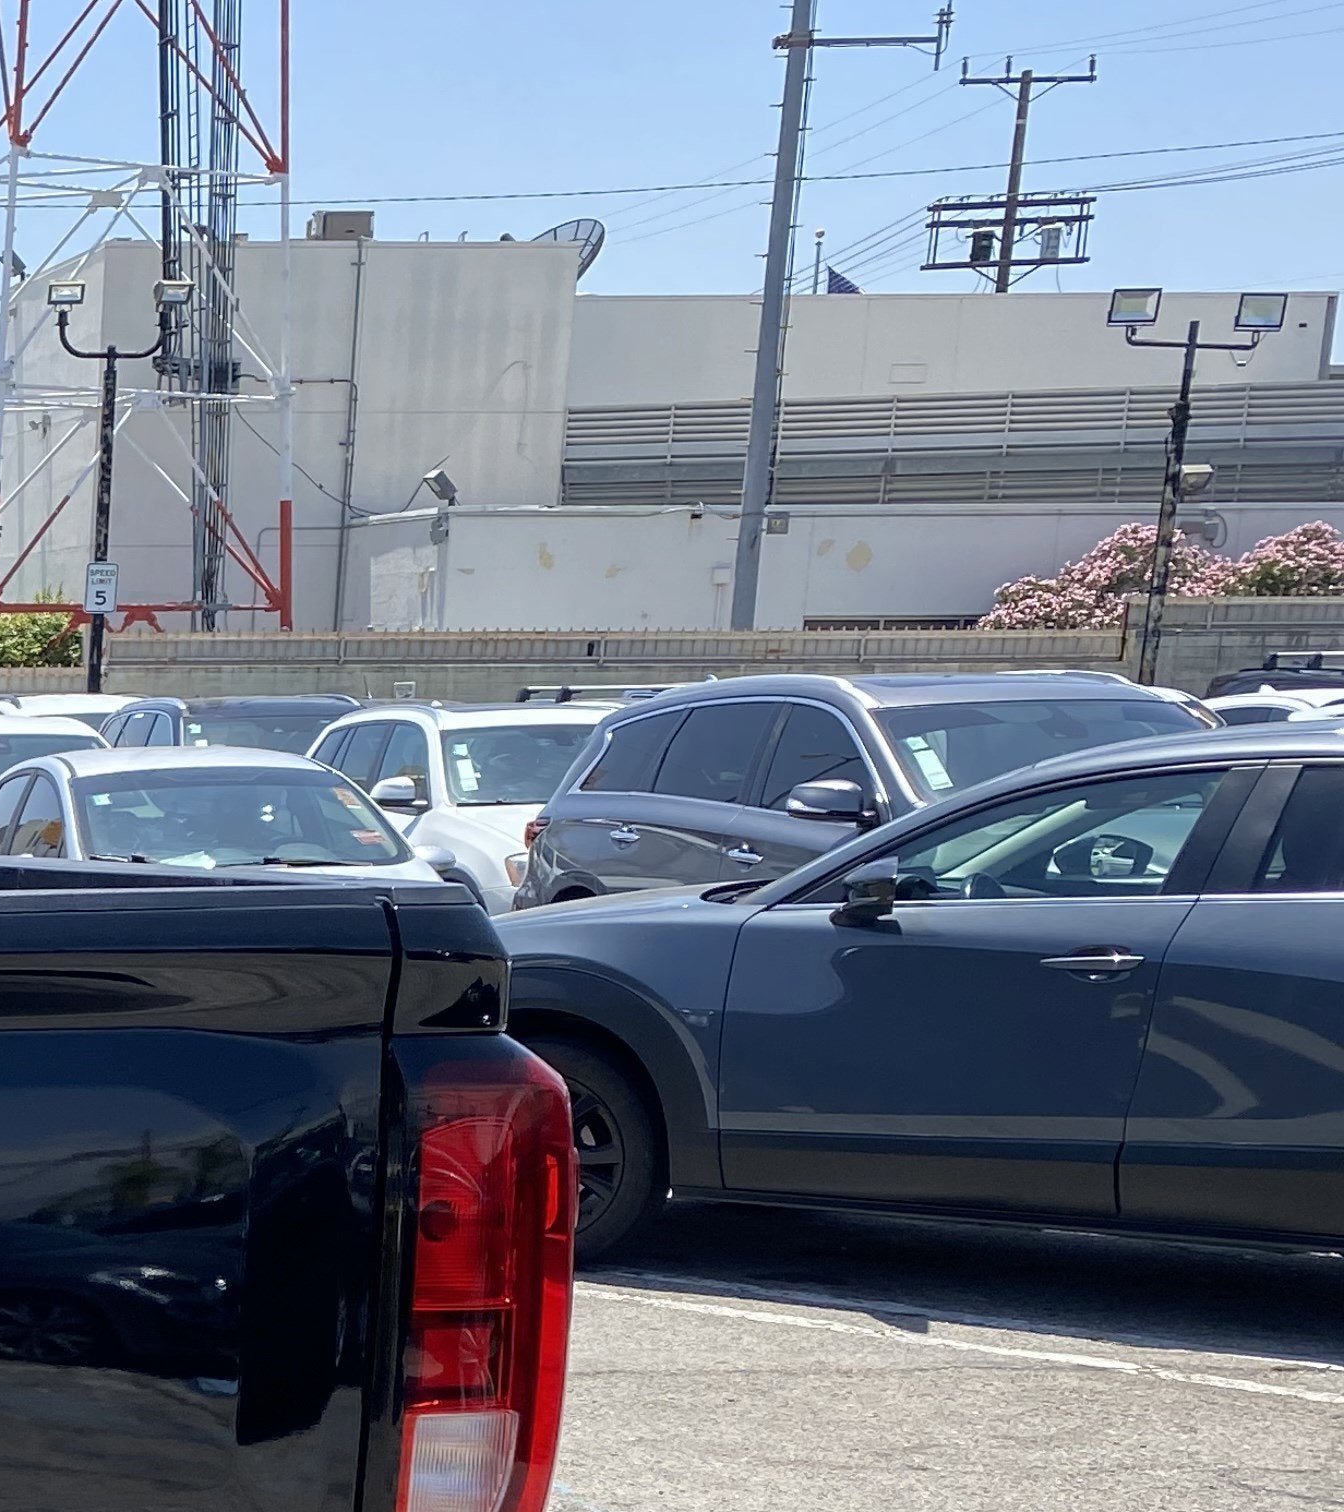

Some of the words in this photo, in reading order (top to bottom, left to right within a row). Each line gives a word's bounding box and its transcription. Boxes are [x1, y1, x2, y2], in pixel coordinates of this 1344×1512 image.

[90, 568, 117, 577] SPEED
[91, 577, 113, 585] LIMIT
[94, 590, 107, 606] 5
